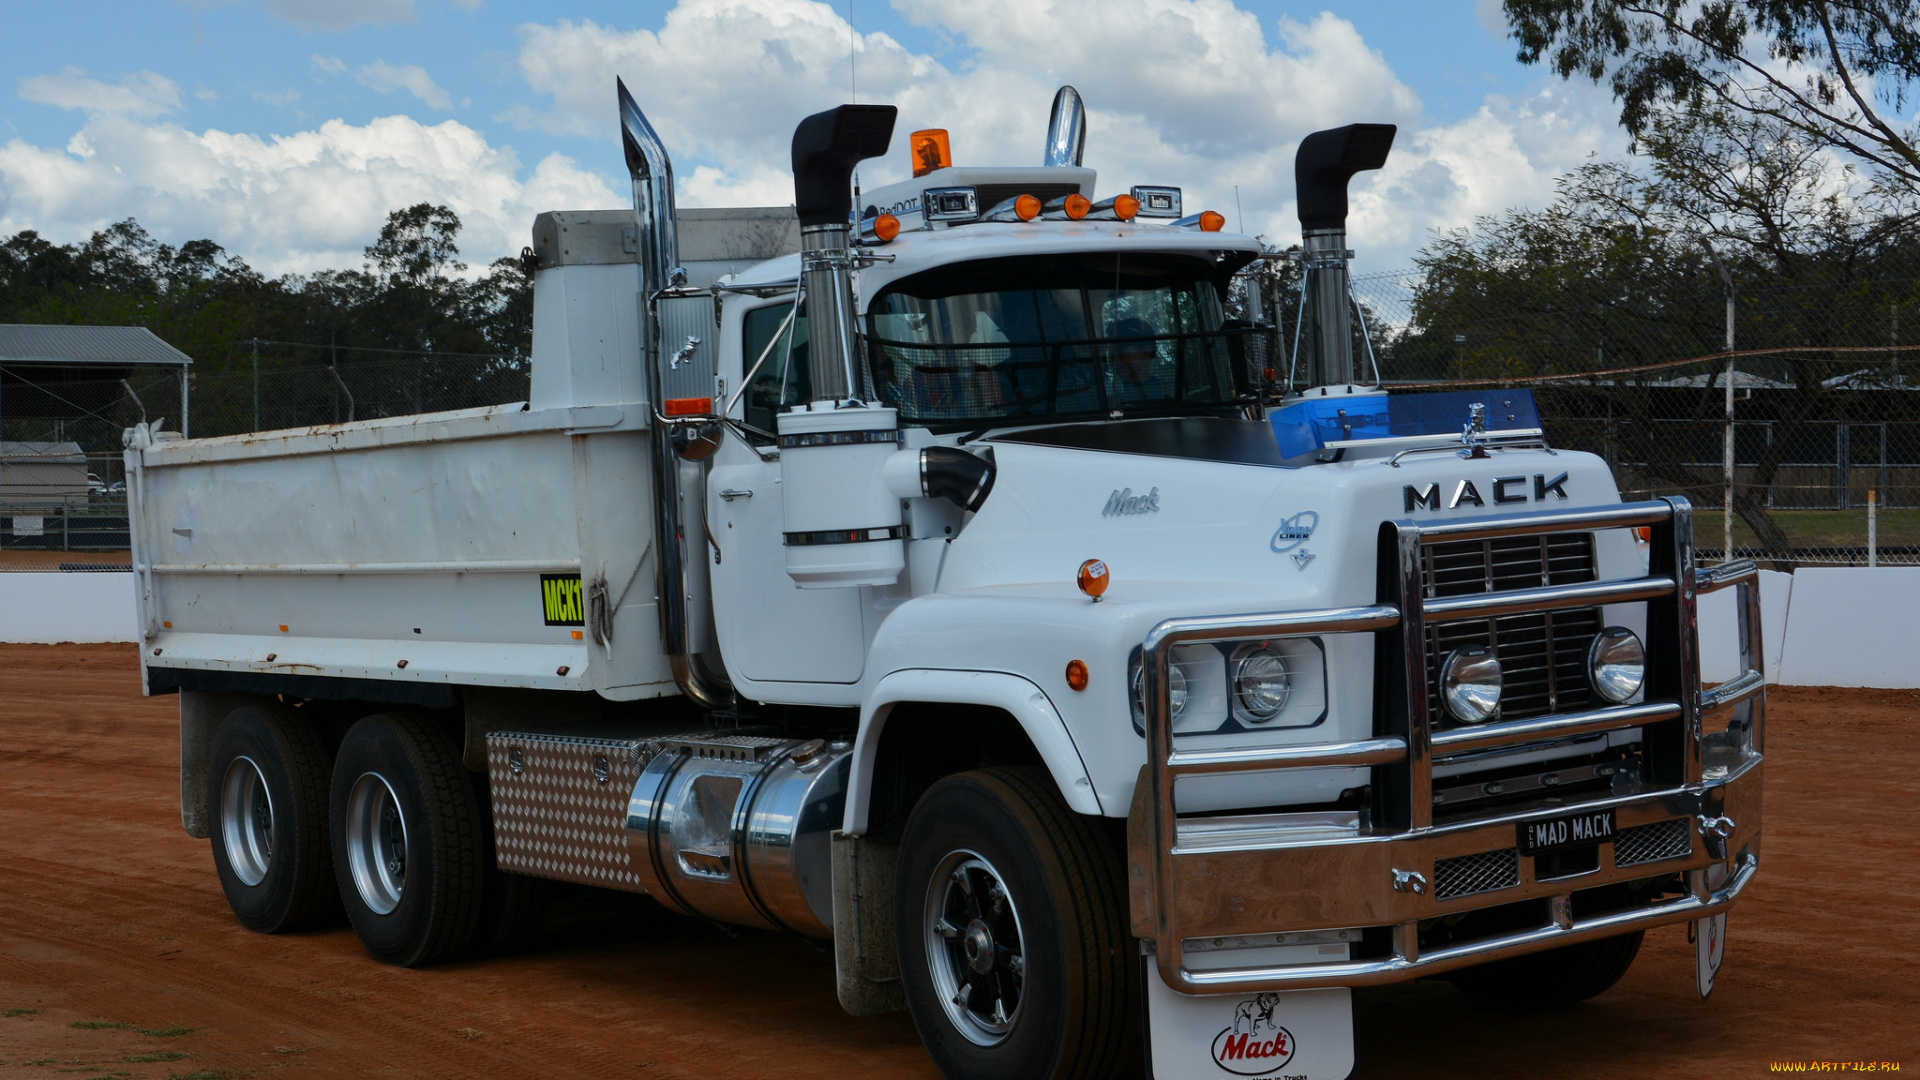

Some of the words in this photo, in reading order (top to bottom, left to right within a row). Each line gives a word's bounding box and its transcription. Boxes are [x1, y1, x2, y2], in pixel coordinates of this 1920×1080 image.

[1101, 486, 1160, 517] Mack
[1403, 471, 1569, 513] MACK
[1279, 533, 1310, 541] LINER
[1536, 821, 1567, 847] MAD
[1573, 813, 1612, 840] MACK
[1219, 1032, 1289, 1061] Mack
